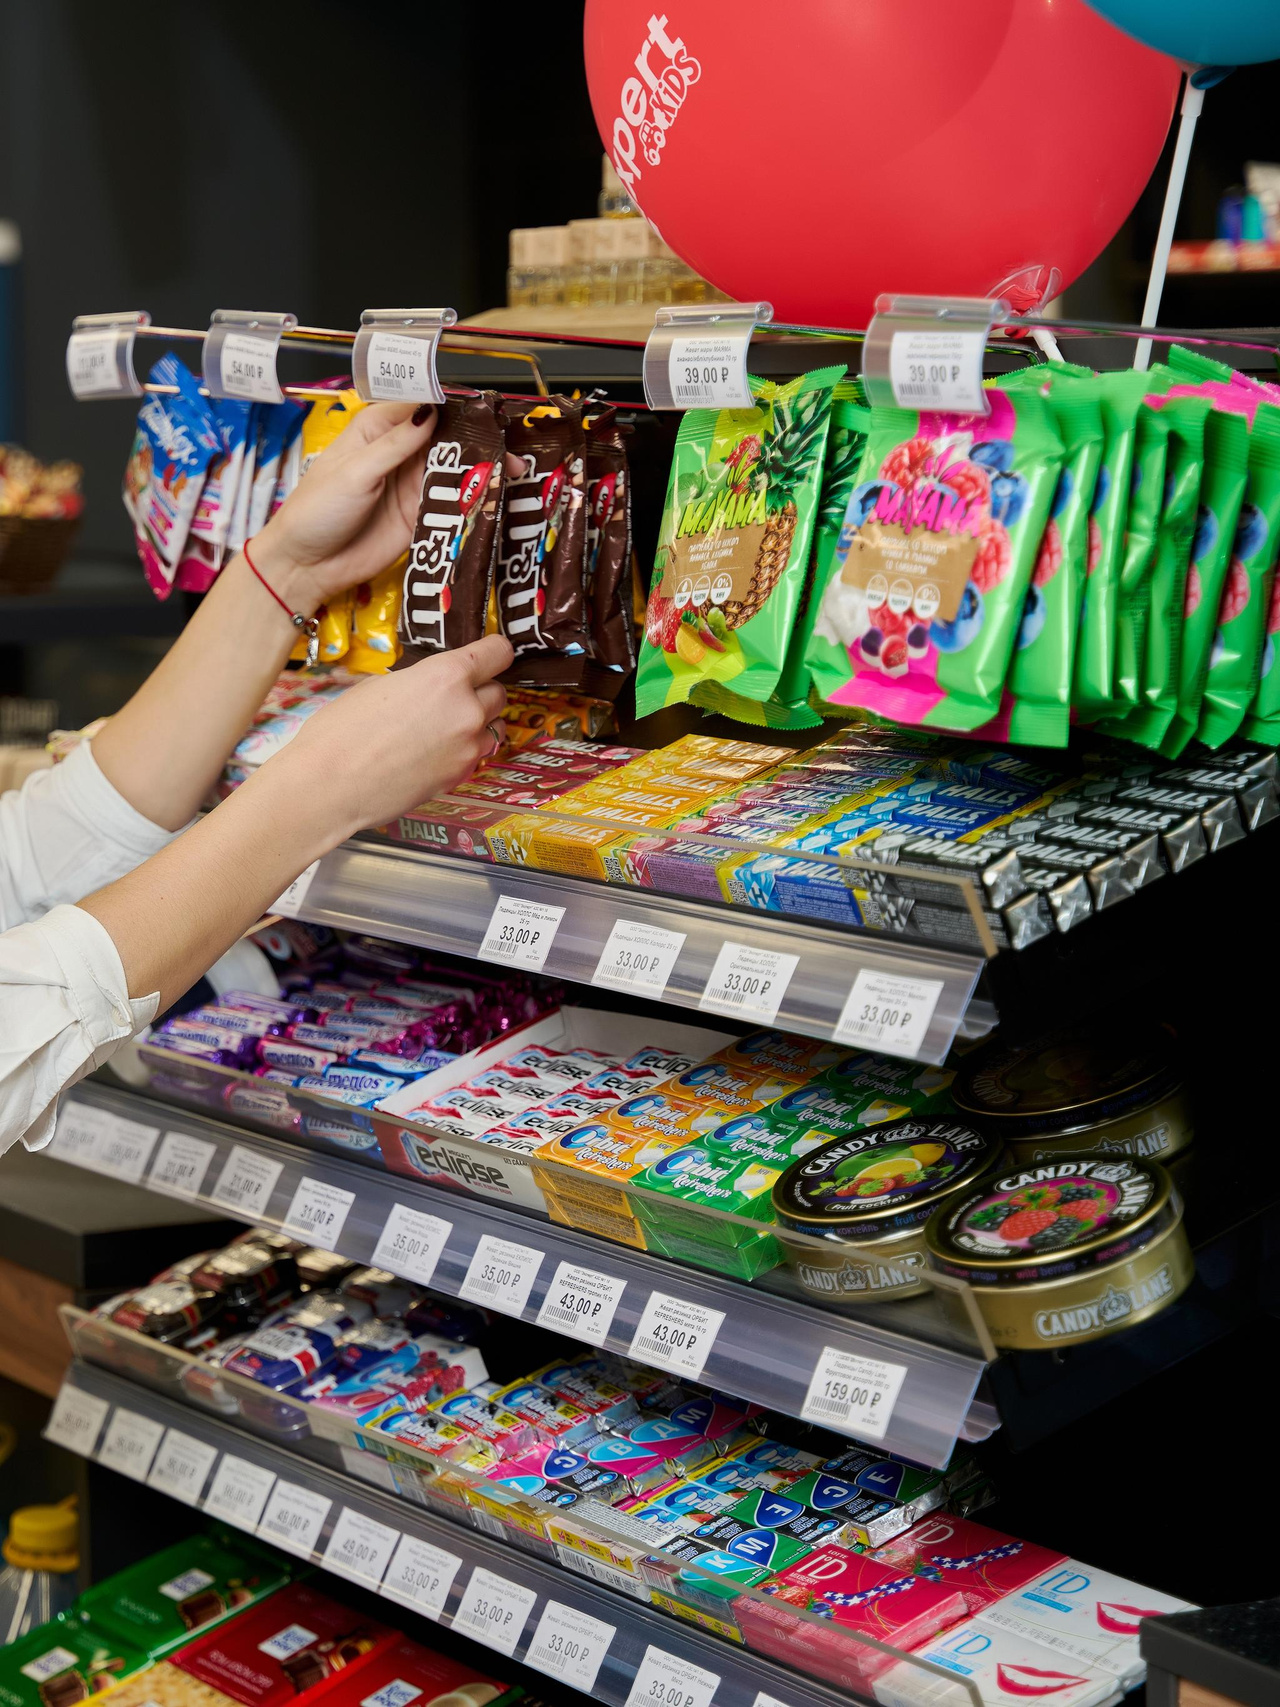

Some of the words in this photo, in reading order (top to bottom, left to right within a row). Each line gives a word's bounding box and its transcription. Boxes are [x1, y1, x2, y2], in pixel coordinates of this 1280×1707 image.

[379, 361, 405, 379] 54,00
[408, 365, 415, 380] ₽
[684, 366, 717, 385] 39,00
[720, 366, 729, 382] ₽
[908, 364, 946, 383] 39,00
[950, 365, 960, 383] ₽
[540, 738, 607, 752] HALLS
[512, 752, 573, 768] HALLS
[854, 756, 921, 771] HALLS
[648, 774, 728, 792] HALLS
[816, 773, 888, 788] HALLS
[1155, 768, 1259, 789] HALLS
[614, 790, 690, 812] HALLS
[774, 788, 854, 806] HALLS
[936, 785, 1027, 807] HALLS
[1117, 785, 1219, 809] HALLS
[583, 805, 659, 826] HALLS
[740, 805, 814, 823] HALLS
[898, 802, 989, 824] HALLS
[1080, 806, 1181, 829] HALLS
[398, 817, 450, 846] HALLS
[540, 822, 616, 844] HALLS
[710, 822, 786, 840] HALLS
[1040, 823, 1141, 848] HALLS
[665, 842, 738, 860] HALLS
[904, 839, 1002, 864] HALLS
[1018, 842, 1108, 867] HALLS
[497, 924, 531, 946] 33,00
[529, 930, 541, 946] ₽
[614, 949, 650, 972] 33,00
[648, 956, 660, 973] ₽
[722, 972, 760, 996] 33,00
[758, 980, 772, 997] ₽
[858, 1003, 900, 1028] 33,00
[899, 1011, 913, 1029] ₽
[736, 1033, 802, 1060] Orbit
[522, 1053, 592, 1080] eclipse
[678, 1064, 752, 1092] Orbit
[328, 1072, 380, 1091] mentos
[485, 1074, 555, 1101] eclipse
[448, 1093, 515, 1120] eclipse
[693, 1085, 751, 1107] Refreshers
[780, 1085, 855, 1116] Orbit
[617, 1094, 690, 1123] Orbit
[796, 1107, 856, 1131] Refreshers
[631, 1115, 689, 1138] Refreshers
[714, 1116, 789, 1146] Orbit
[559, 1124, 632, 1154] Orbit
[729, 1139, 790, 1163] Refreshers
[803, 1133, 879, 1175] CANDY
[929, 1122, 982, 1152] LANE
[416, 1145, 510, 1189] eclipse
[575, 1146, 634, 1171] Refreshers
[655, 1149, 733, 1181] Orbit
[672, 1172, 733, 1200] Refreshers
[999, 1162, 1096, 1191] CANDY
[1114, 1175, 1152, 1216] LANE
[298, 1203, 327, 1225] 31,00
[325, 1212, 335, 1226] ₽
[894, 1213, 917, 1226] fruit
[837, 1224, 879, 1236] коктейль
[392, 1232, 421, 1256] 35,00
[419, 1243, 430, 1258] ₽
[480, 1263, 512, 1287] 35,00
[510, 1273, 521, 1288] ₽
[799, 1266, 838, 1291] CANDY
[1016, 1268, 1039, 1279] wild
[1040, 1261, 1076, 1276] berries
[558, 1278, 587, 1293] REFRESHERS
[596, 1282, 612, 1292] ОРБИТ
[557, 1291, 592, 1316] 43,00
[590, 1302, 602, 1318] ₽
[1036, 1306, 1102, 1336] CANDY
[1129, 1269, 1171, 1311] LANE
[653, 1310, 684, 1325] REFRESHERS
[690, 1314, 708, 1324] ОРБИТ
[650, 1322, 687, 1349] 43,00
[684, 1334, 698, 1351] ₽
[820, 1378, 870, 1409] 159,00
[868, 1391, 883, 1409] ₽
[341, 1536, 369, 1561] 49,00
[368, 1549, 378, 1564] ₽
[827, 1549, 849, 1559] LOTTE
[400, 1564, 430, 1591] 33,00
[429, 1577, 440, 1594] ₽
[472, 1597, 504, 1625] 33,00
[501, 1610, 513, 1627] ₽
[546, 1632, 580, 1660] 33,00
[579, 1646, 590, 1663] ₽
[577, 1626, 593, 1638] ОРБИТ
[592, 1633, 607, 1645] Арбуз
[661, 1663, 680, 1675] резинка
[680, 1670, 697, 1682] ОРБИТ
[696, 1677, 715, 1690] Нежная
[670, 1675, 683, 1685] Мята
[647, 1678, 684, 1707] 33,00
[682, 1694, 695, 1707] ₽
